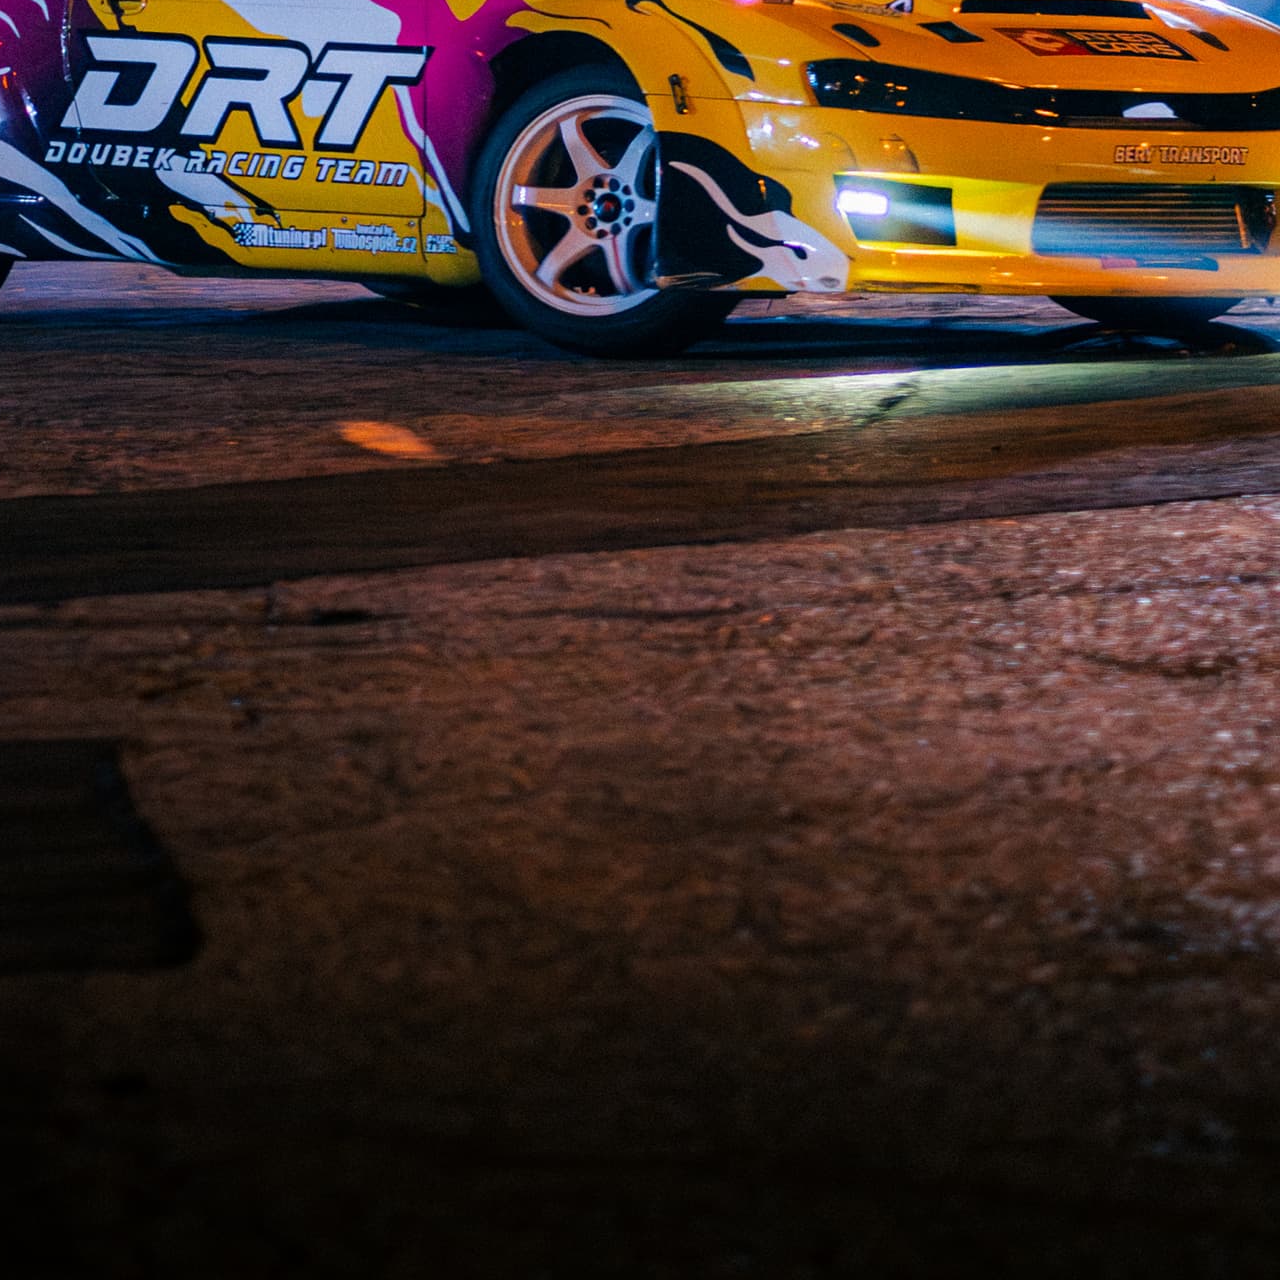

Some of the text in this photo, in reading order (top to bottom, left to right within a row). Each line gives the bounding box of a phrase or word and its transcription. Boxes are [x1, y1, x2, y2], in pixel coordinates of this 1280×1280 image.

[1085, 41, 1183, 57] CARS
[58, 34, 429, 149] DRT
[44, 140, 410, 187] DOUBEK RACING TEAM
[1160, 147, 1248, 165] TRANSPORT
